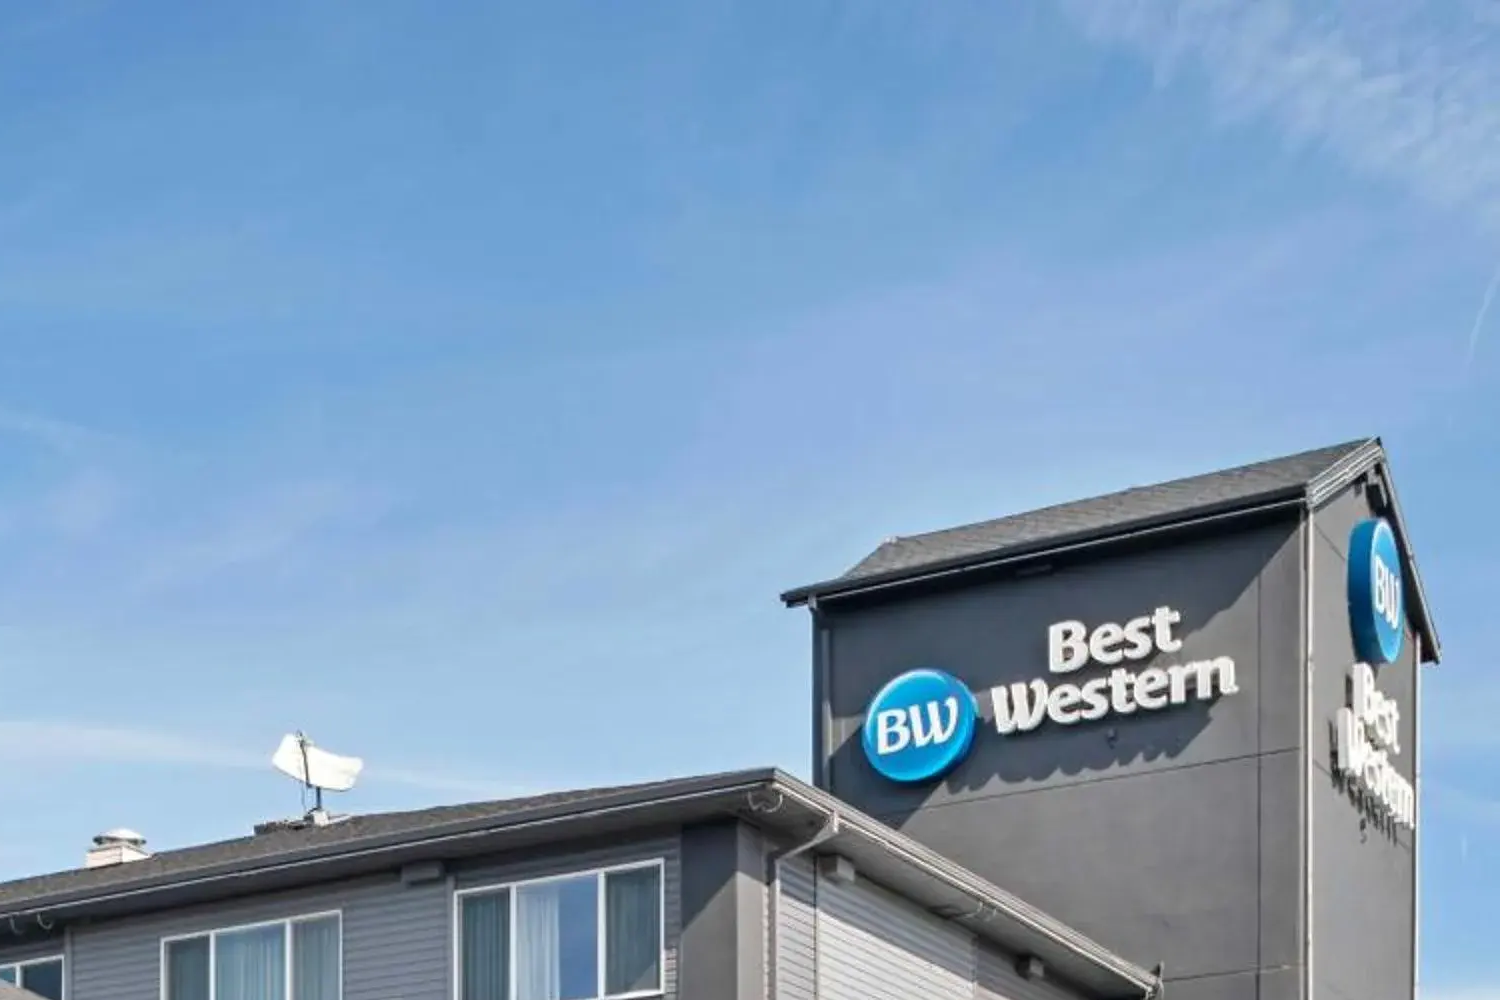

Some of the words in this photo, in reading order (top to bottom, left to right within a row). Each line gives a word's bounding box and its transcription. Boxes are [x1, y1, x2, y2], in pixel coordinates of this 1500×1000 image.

[1374, 554, 1401, 630] BW
[1047, 605, 1183, 673] Best
[876, 696, 959, 755] BW
[990, 655, 1240, 735] Western
[1352, 661, 1401, 755] Best
